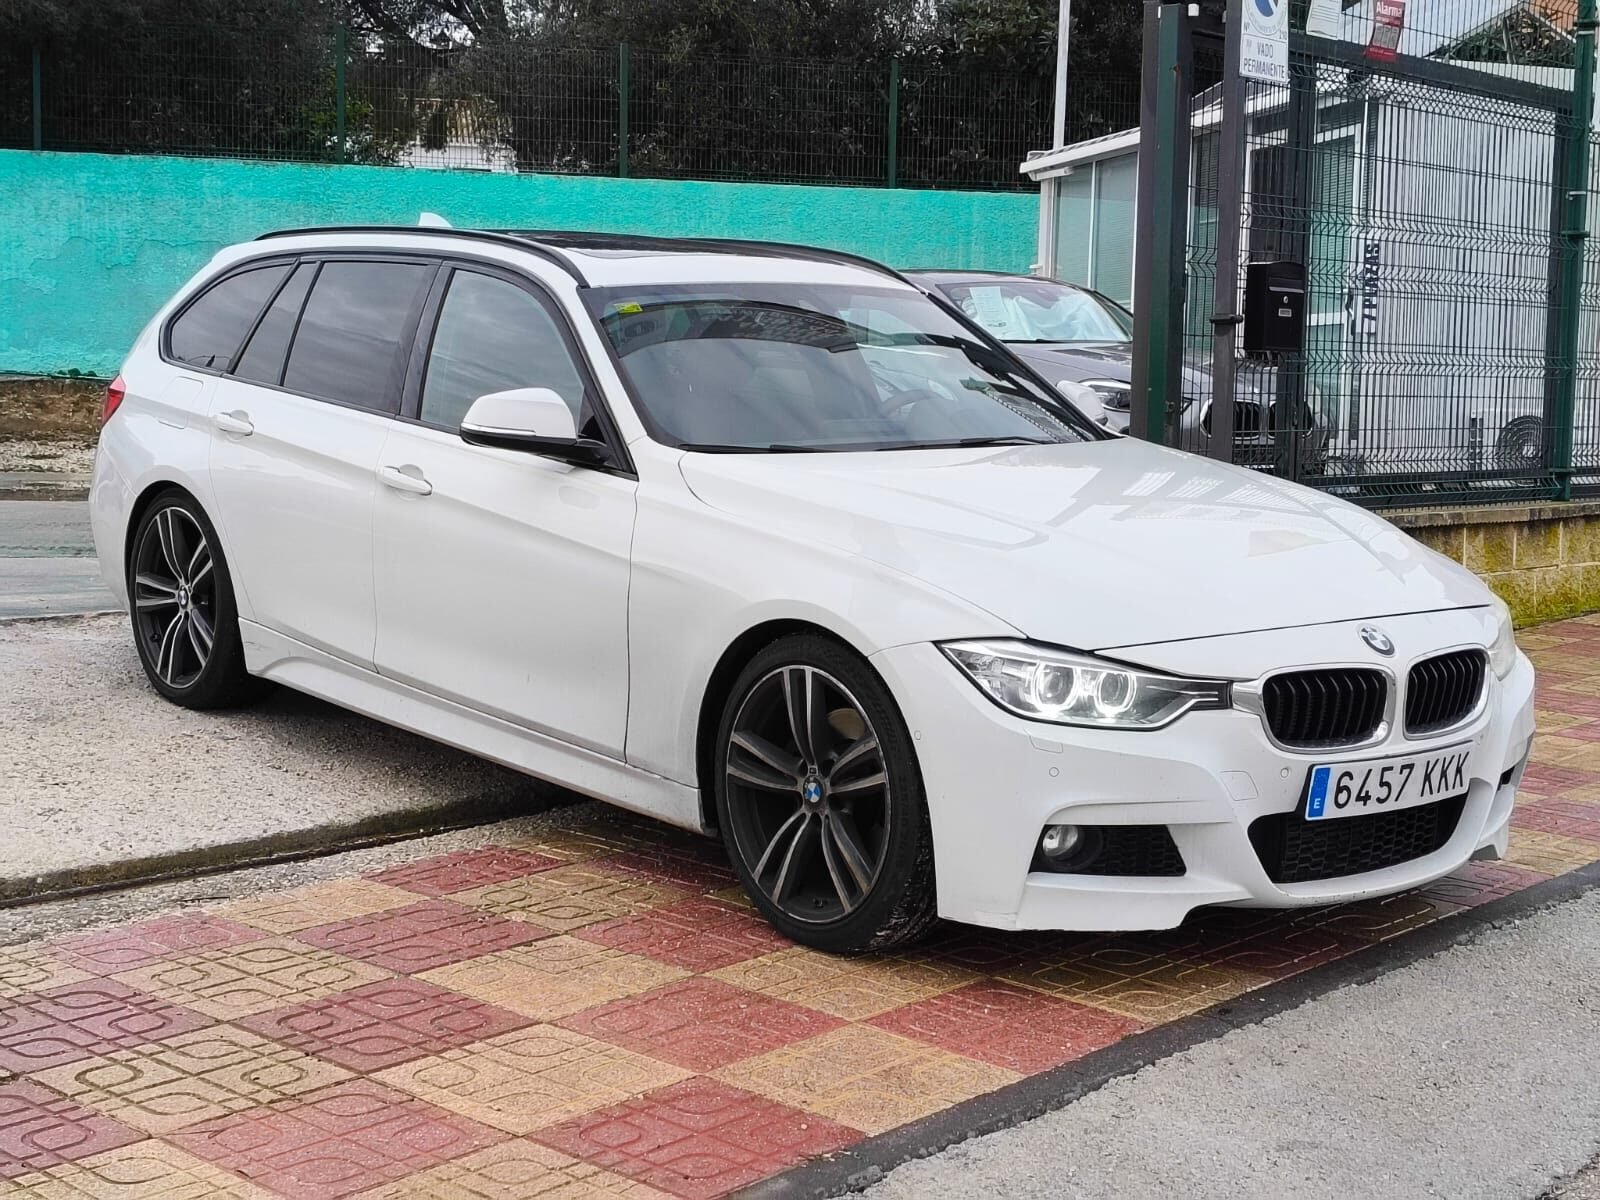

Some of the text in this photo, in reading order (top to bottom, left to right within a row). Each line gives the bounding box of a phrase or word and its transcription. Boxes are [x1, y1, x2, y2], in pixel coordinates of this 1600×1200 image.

[1376, 1, 1403, 18] Alarma
[1257, 40, 1274, 58] VADO
[1243, 58, 1285, 79] PERMANENTE
[1334, 751, 1470, 809] 6457 KKK
[1313, 798, 1321, 809] E
